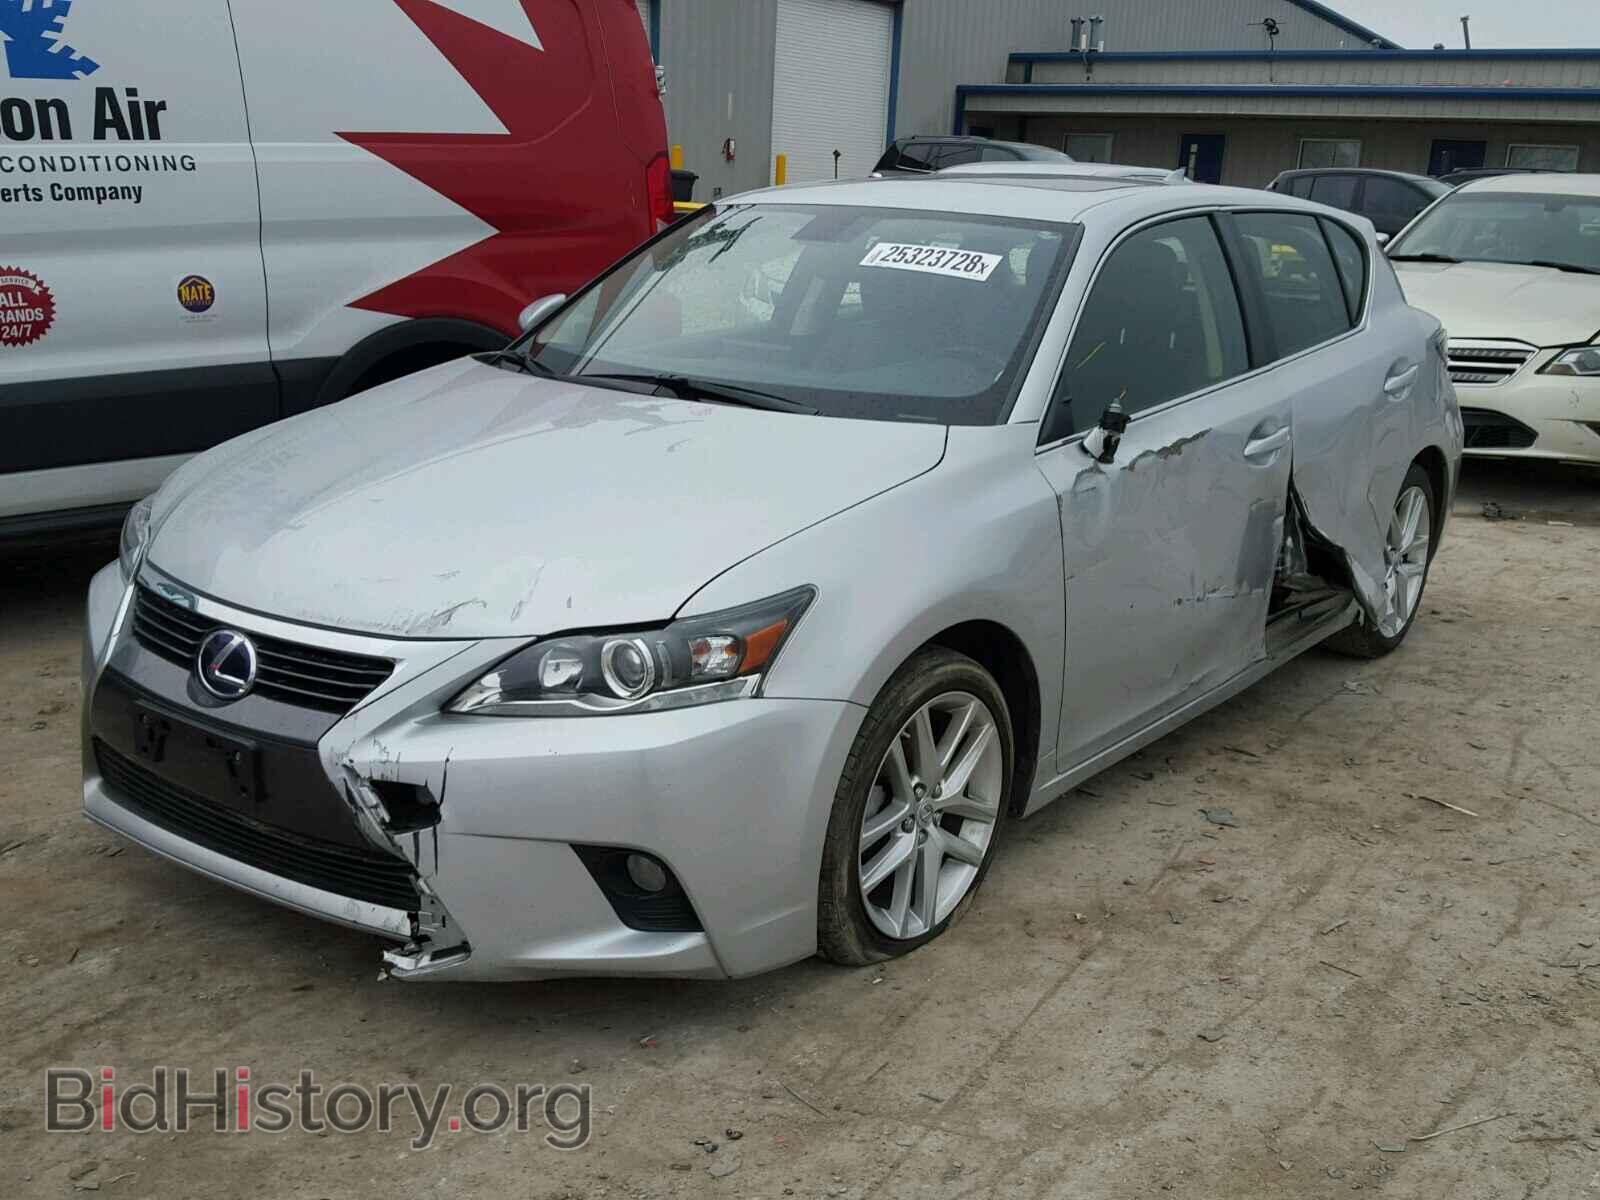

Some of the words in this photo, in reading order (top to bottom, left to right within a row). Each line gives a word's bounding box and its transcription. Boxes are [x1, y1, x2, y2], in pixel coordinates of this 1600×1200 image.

[0, 97, 73, 141] on
[93, 86, 168, 141] Air
[0, 154, 197, 173] CONDITIONING
[0, 183, 44, 202] erts
[50, 182, 142, 204] Company
[181, 284, 212, 301] NATE
[1, 324, 32, 338] 24/7
